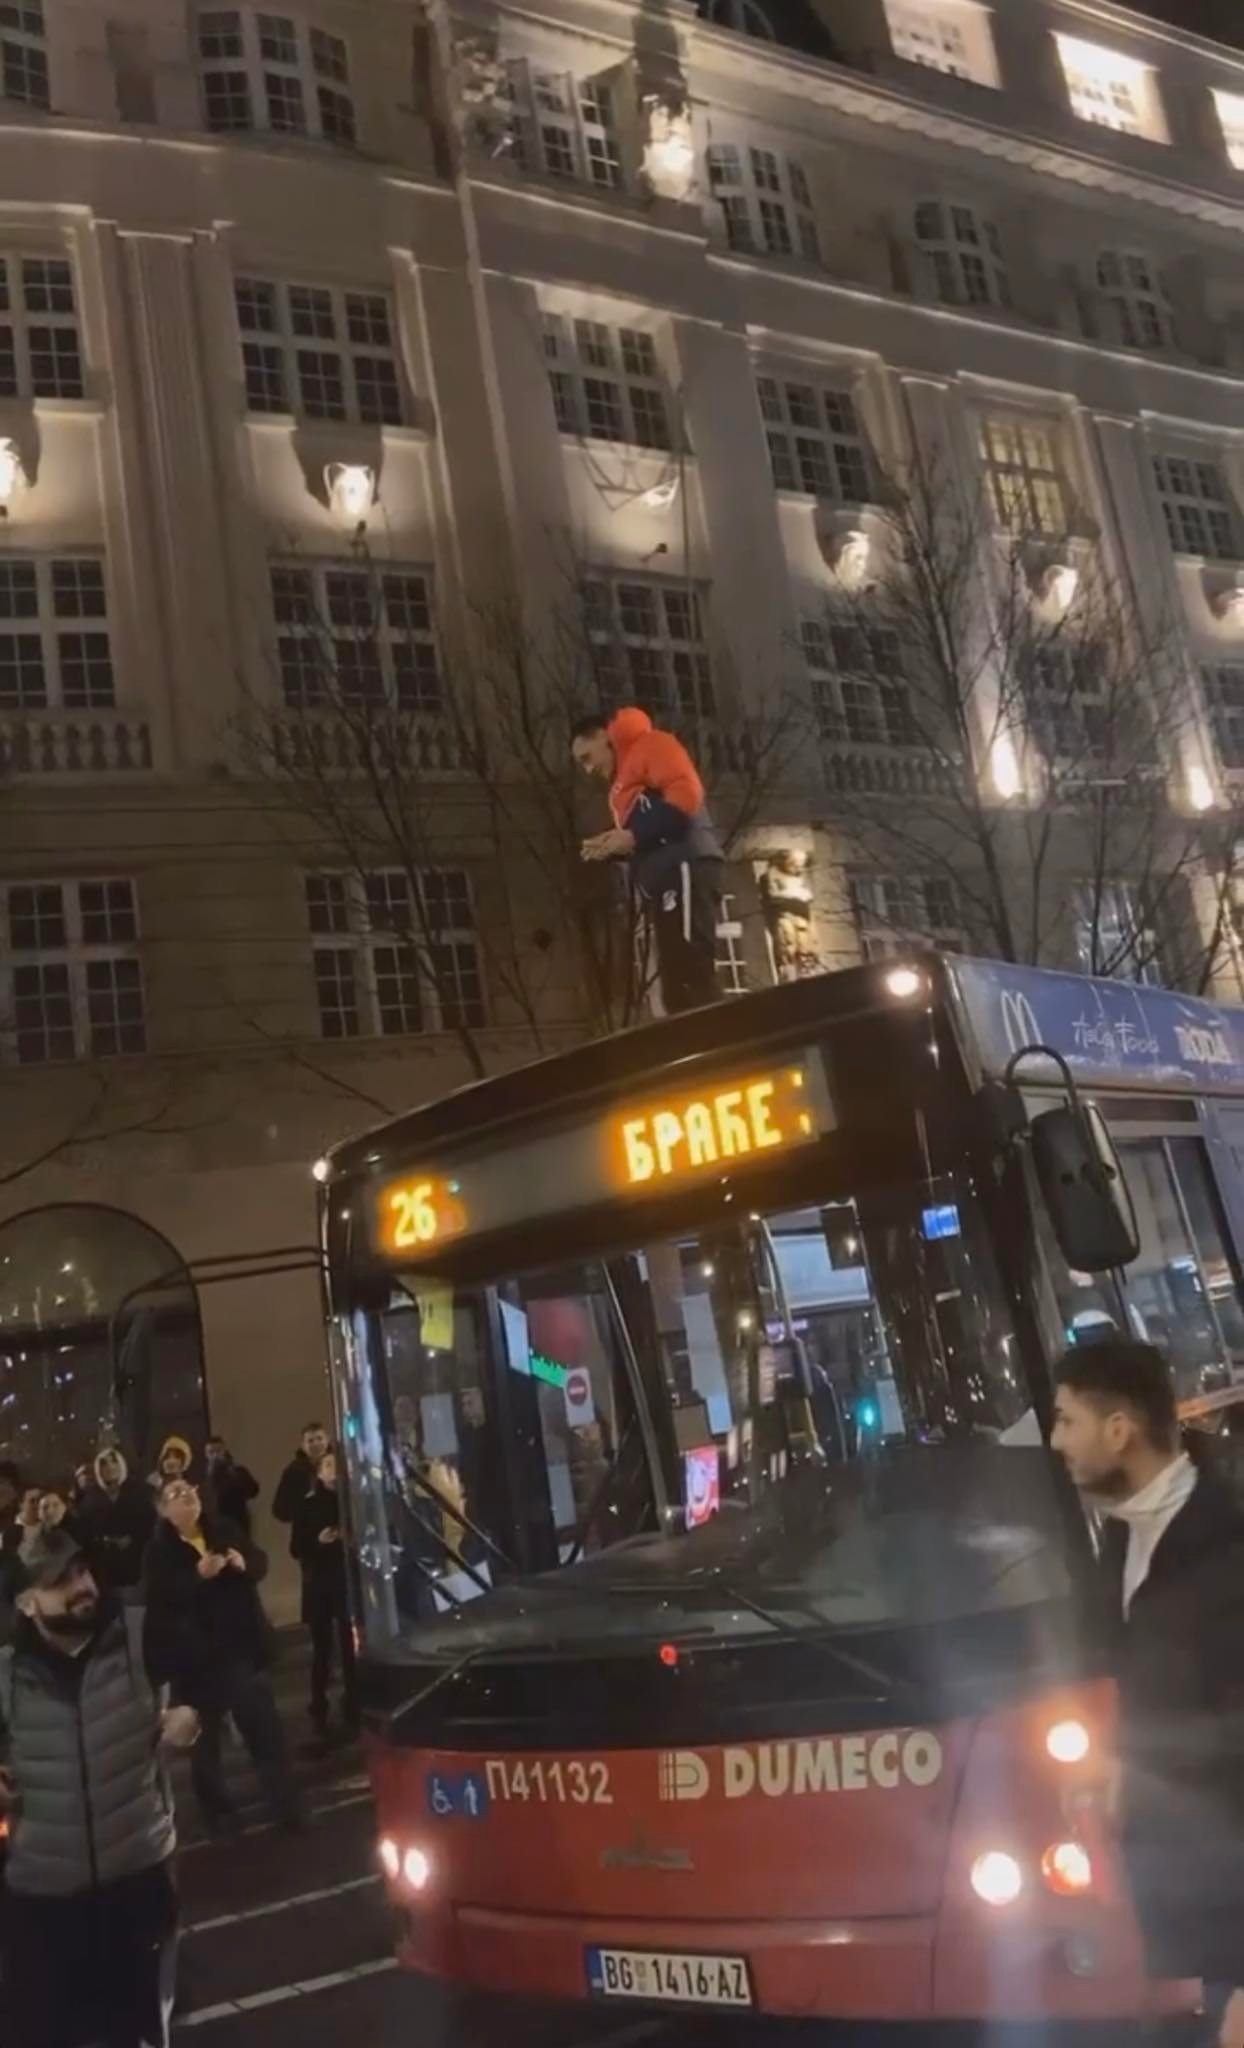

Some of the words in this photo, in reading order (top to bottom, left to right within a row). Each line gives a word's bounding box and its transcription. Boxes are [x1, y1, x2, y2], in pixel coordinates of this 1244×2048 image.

[390, 1184, 436, 1247] 26
[622, 1080, 782, 1183] БРАЋЕ
[485, 1760, 613, 1804] П41132
[724, 1730, 942, 1798] DUMECO
[604, 1956, 634, 1991] BG
